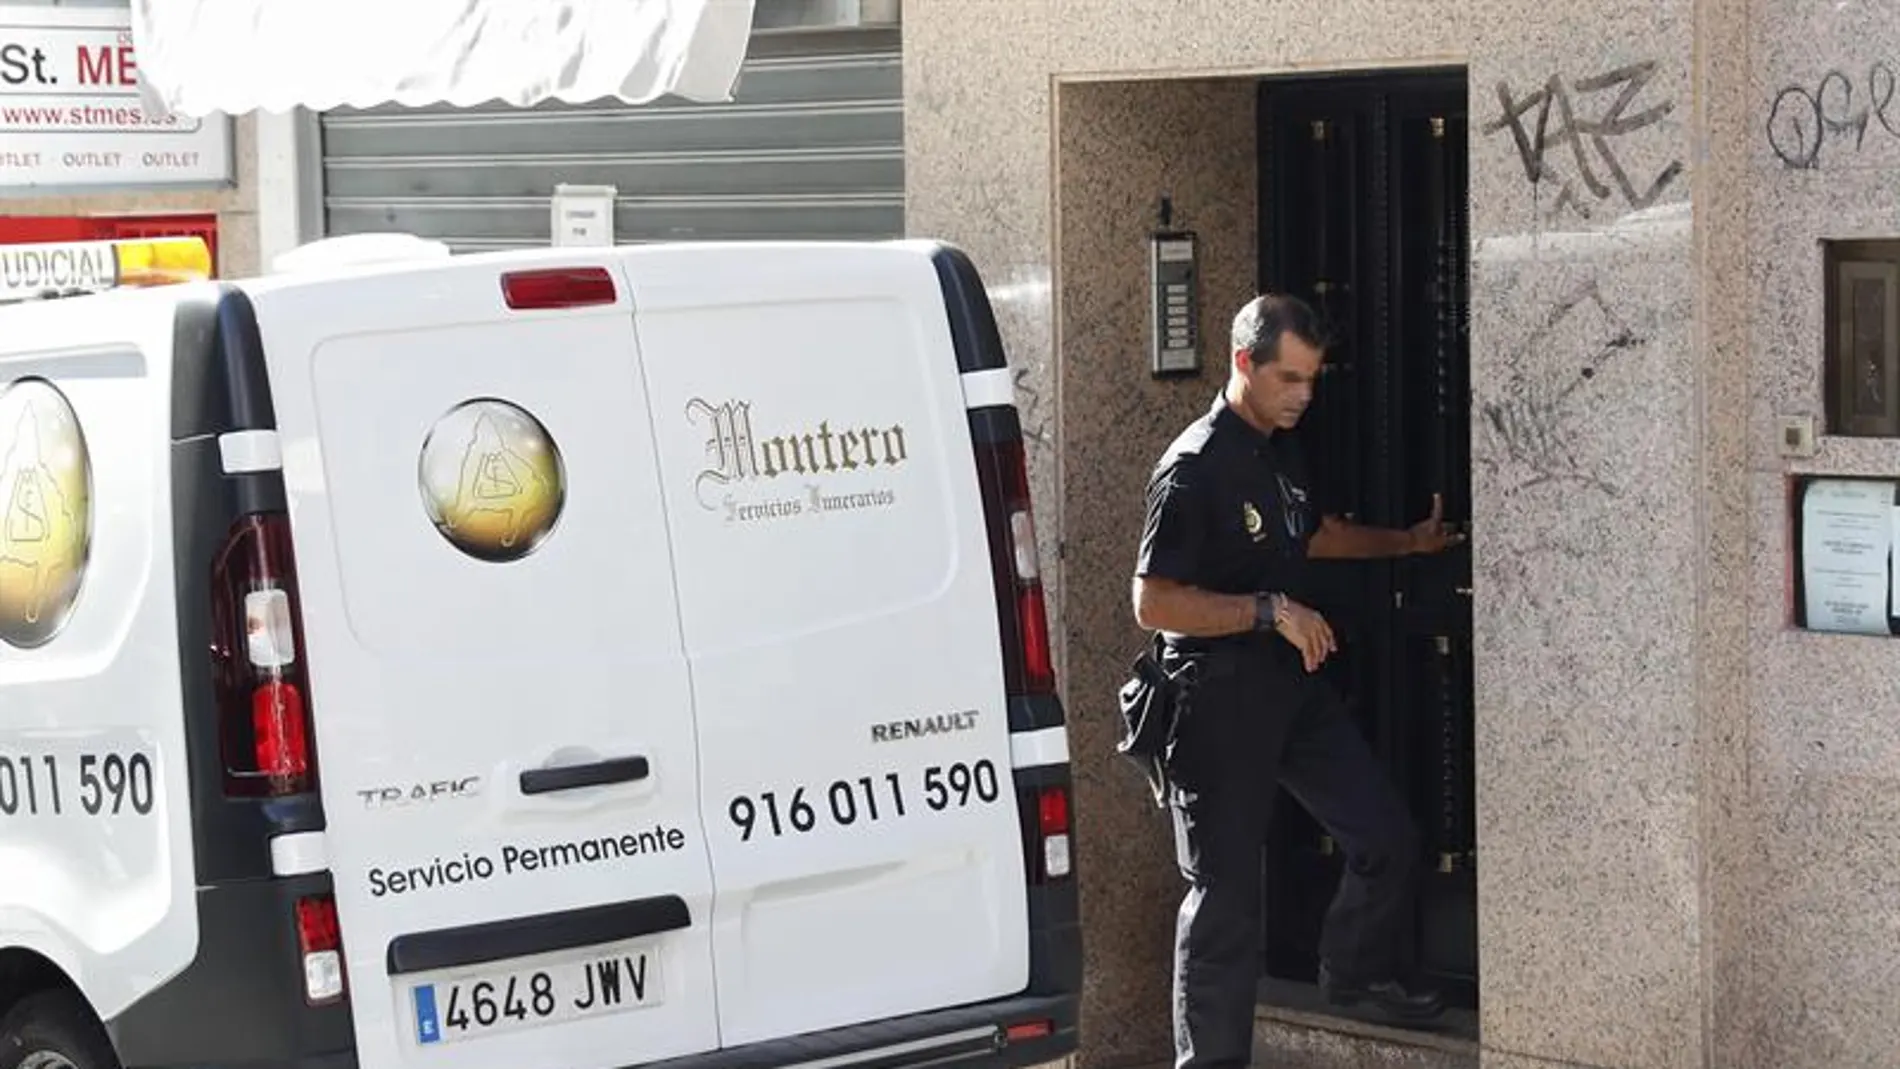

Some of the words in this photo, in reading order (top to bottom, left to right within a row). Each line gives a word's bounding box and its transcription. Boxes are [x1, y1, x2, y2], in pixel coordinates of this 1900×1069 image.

[0, 44, 58, 85] St.
[63, 151, 121, 167] OUTLET
[142, 152, 199, 167] OUTLET
[686, 397, 907, 510] Montero
[871, 710, 980, 742] RENAULT
[80, 752, 153, 816] 590
[356, 775, 481, 809] TRAFIC
[728, 787, 816, 842] 916
[828, 772, 906, 826] 011
[924, 759, 1000, 812] 590
[368, 853, 494, 897] Servicio
[502, 824, 686, 874] Permanente
[446, 972, 557, 1031] 4648
[574, 954, 649, 1010] JWV
